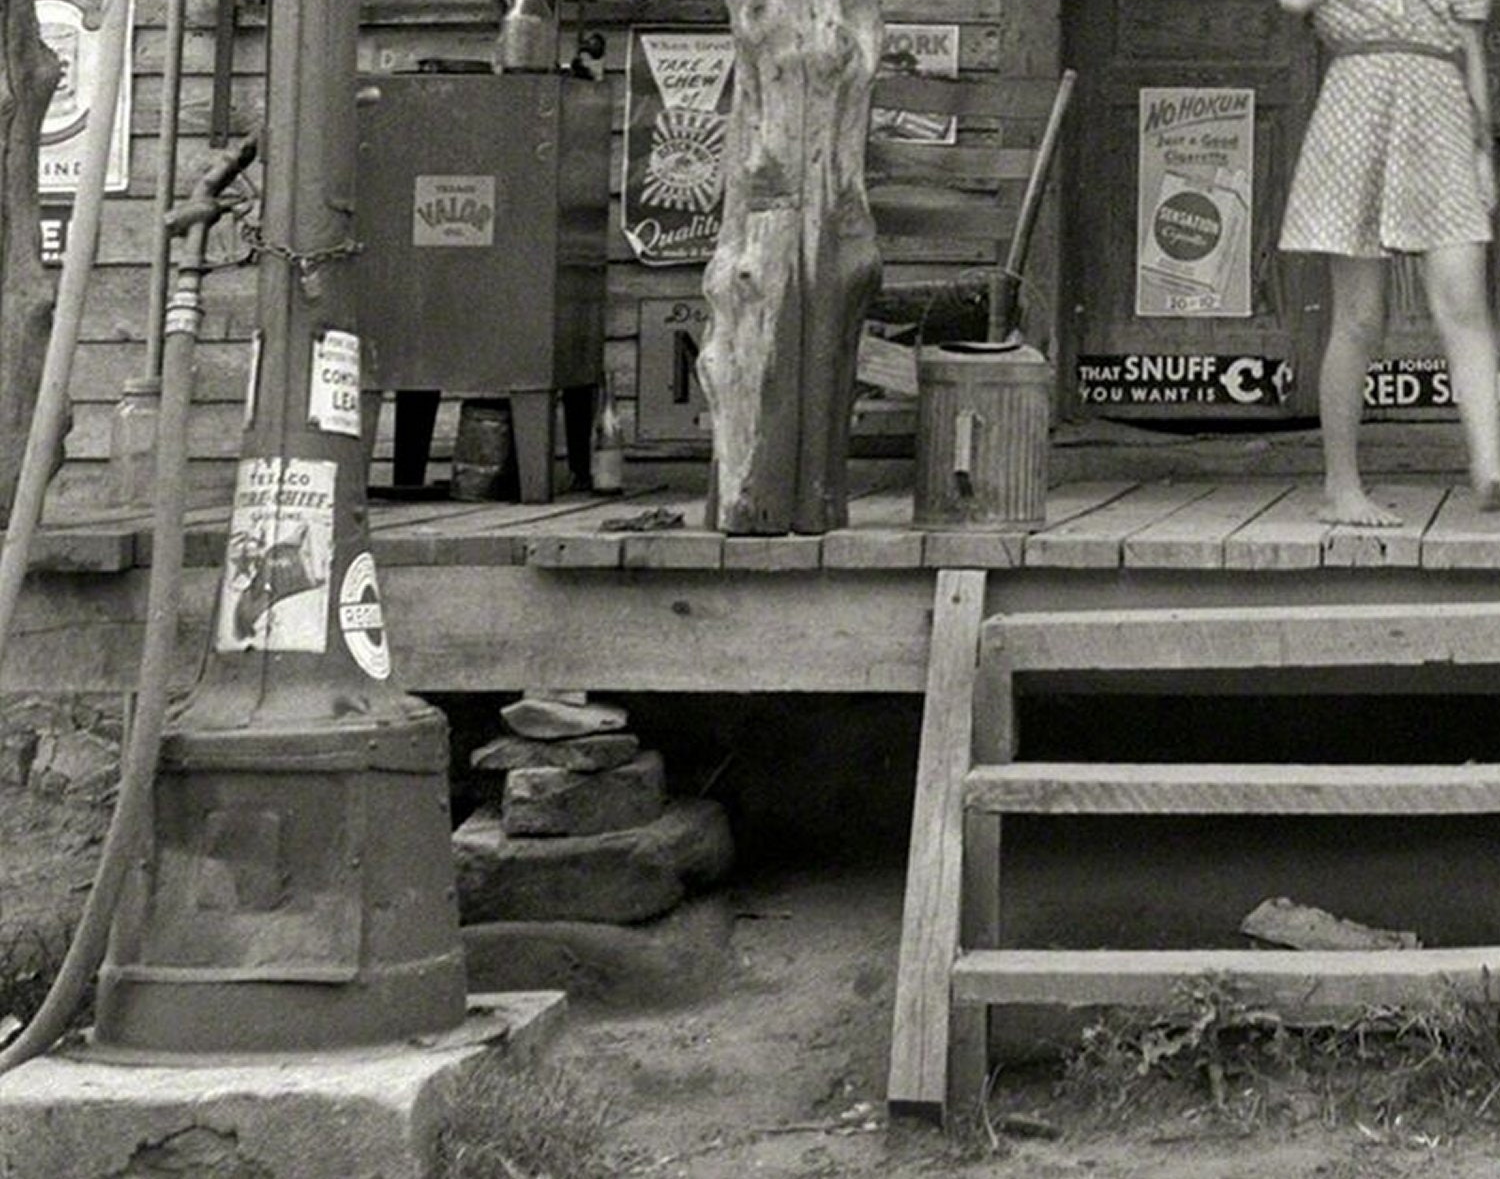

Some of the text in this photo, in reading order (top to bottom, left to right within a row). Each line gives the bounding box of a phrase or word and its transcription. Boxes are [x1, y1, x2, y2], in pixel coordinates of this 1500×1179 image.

[657, 58, 724, 72] TAKE A
[663, 74, 719, 89] CHEW
[681, 91, 700, 108] of
[1144, 99, 1176, 133] NO
[1159, 206, 1220, 235] SENSATION
[1079, 356, 1217, 382] THAT SNUFF
[1399, 359, 1448, 372] FORGET
[1078, 386, 1216, 402] YOU WANT IS
[1363, 374, 1421, 405] RED
